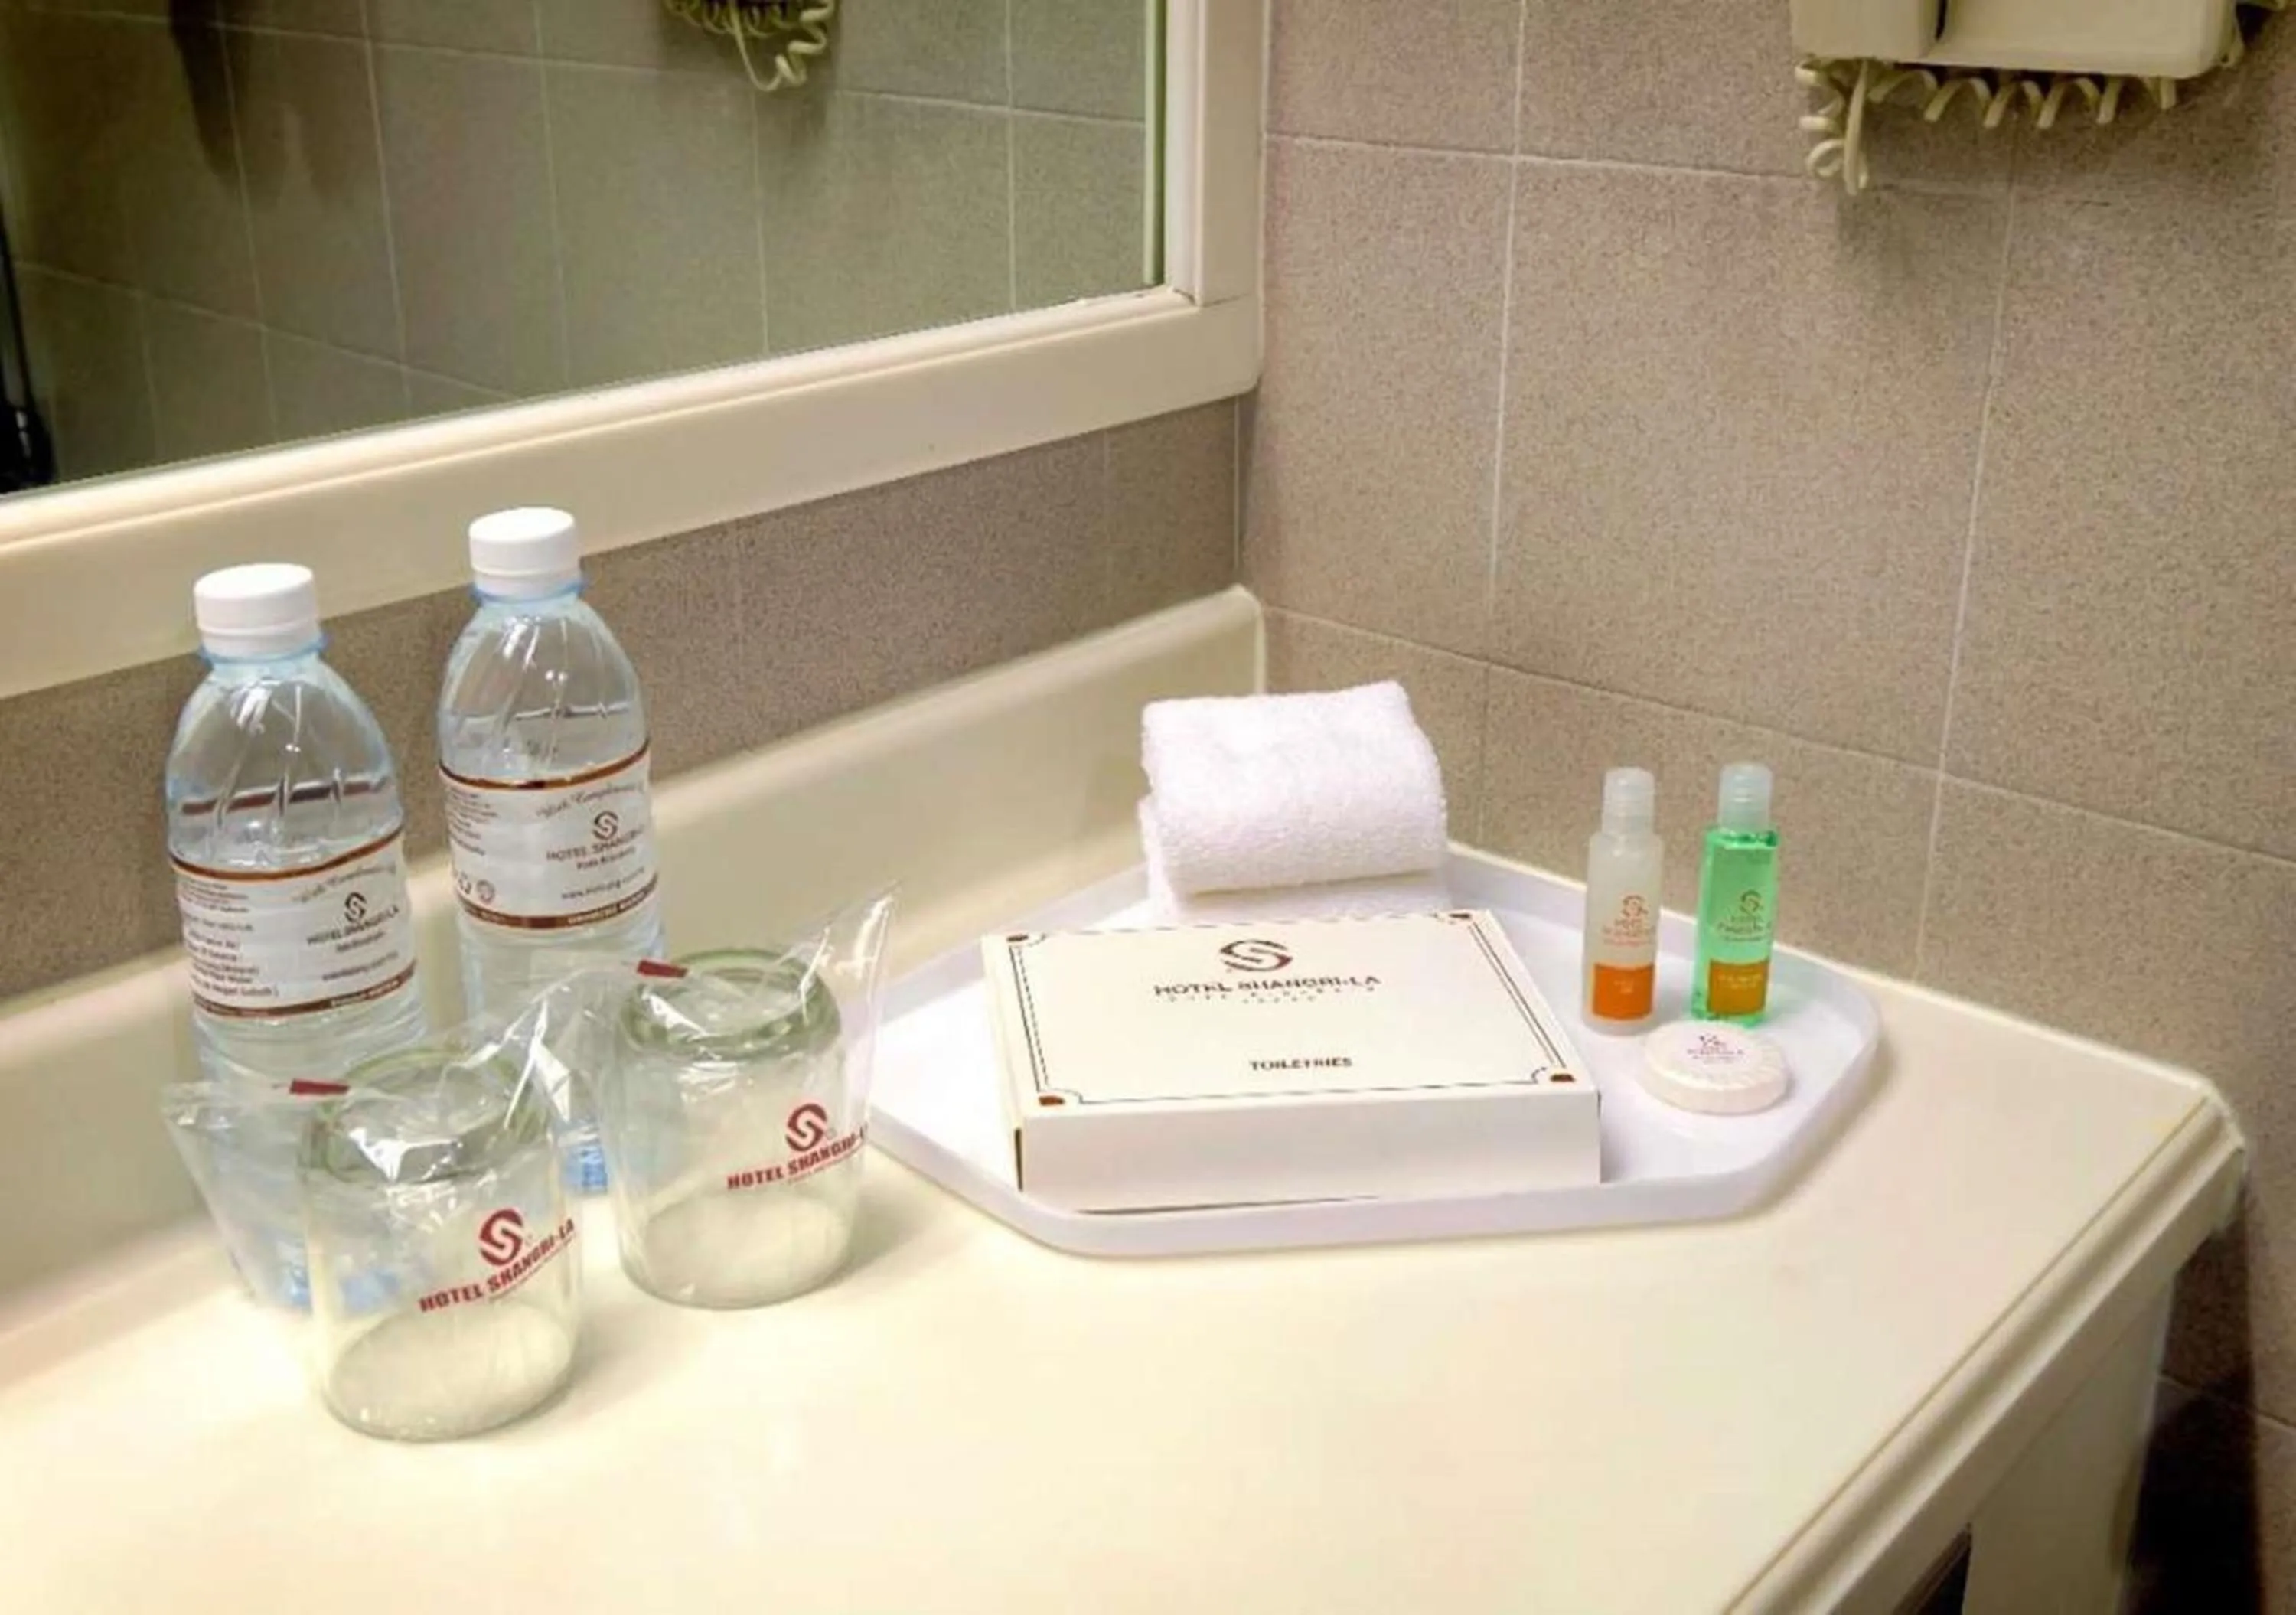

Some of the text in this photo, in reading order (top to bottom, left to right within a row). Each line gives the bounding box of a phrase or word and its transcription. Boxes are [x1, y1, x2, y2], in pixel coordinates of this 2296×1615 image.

[1153, 975, 1383, 996] HOTEL SHANGRI-LA
[1249, 1057, 1353, 1072] TOILETRIES
[727, 1166, 785, 1190] HOTEL
[419, 1218, 575, 1313] HOTEL SHANGRI-LA
